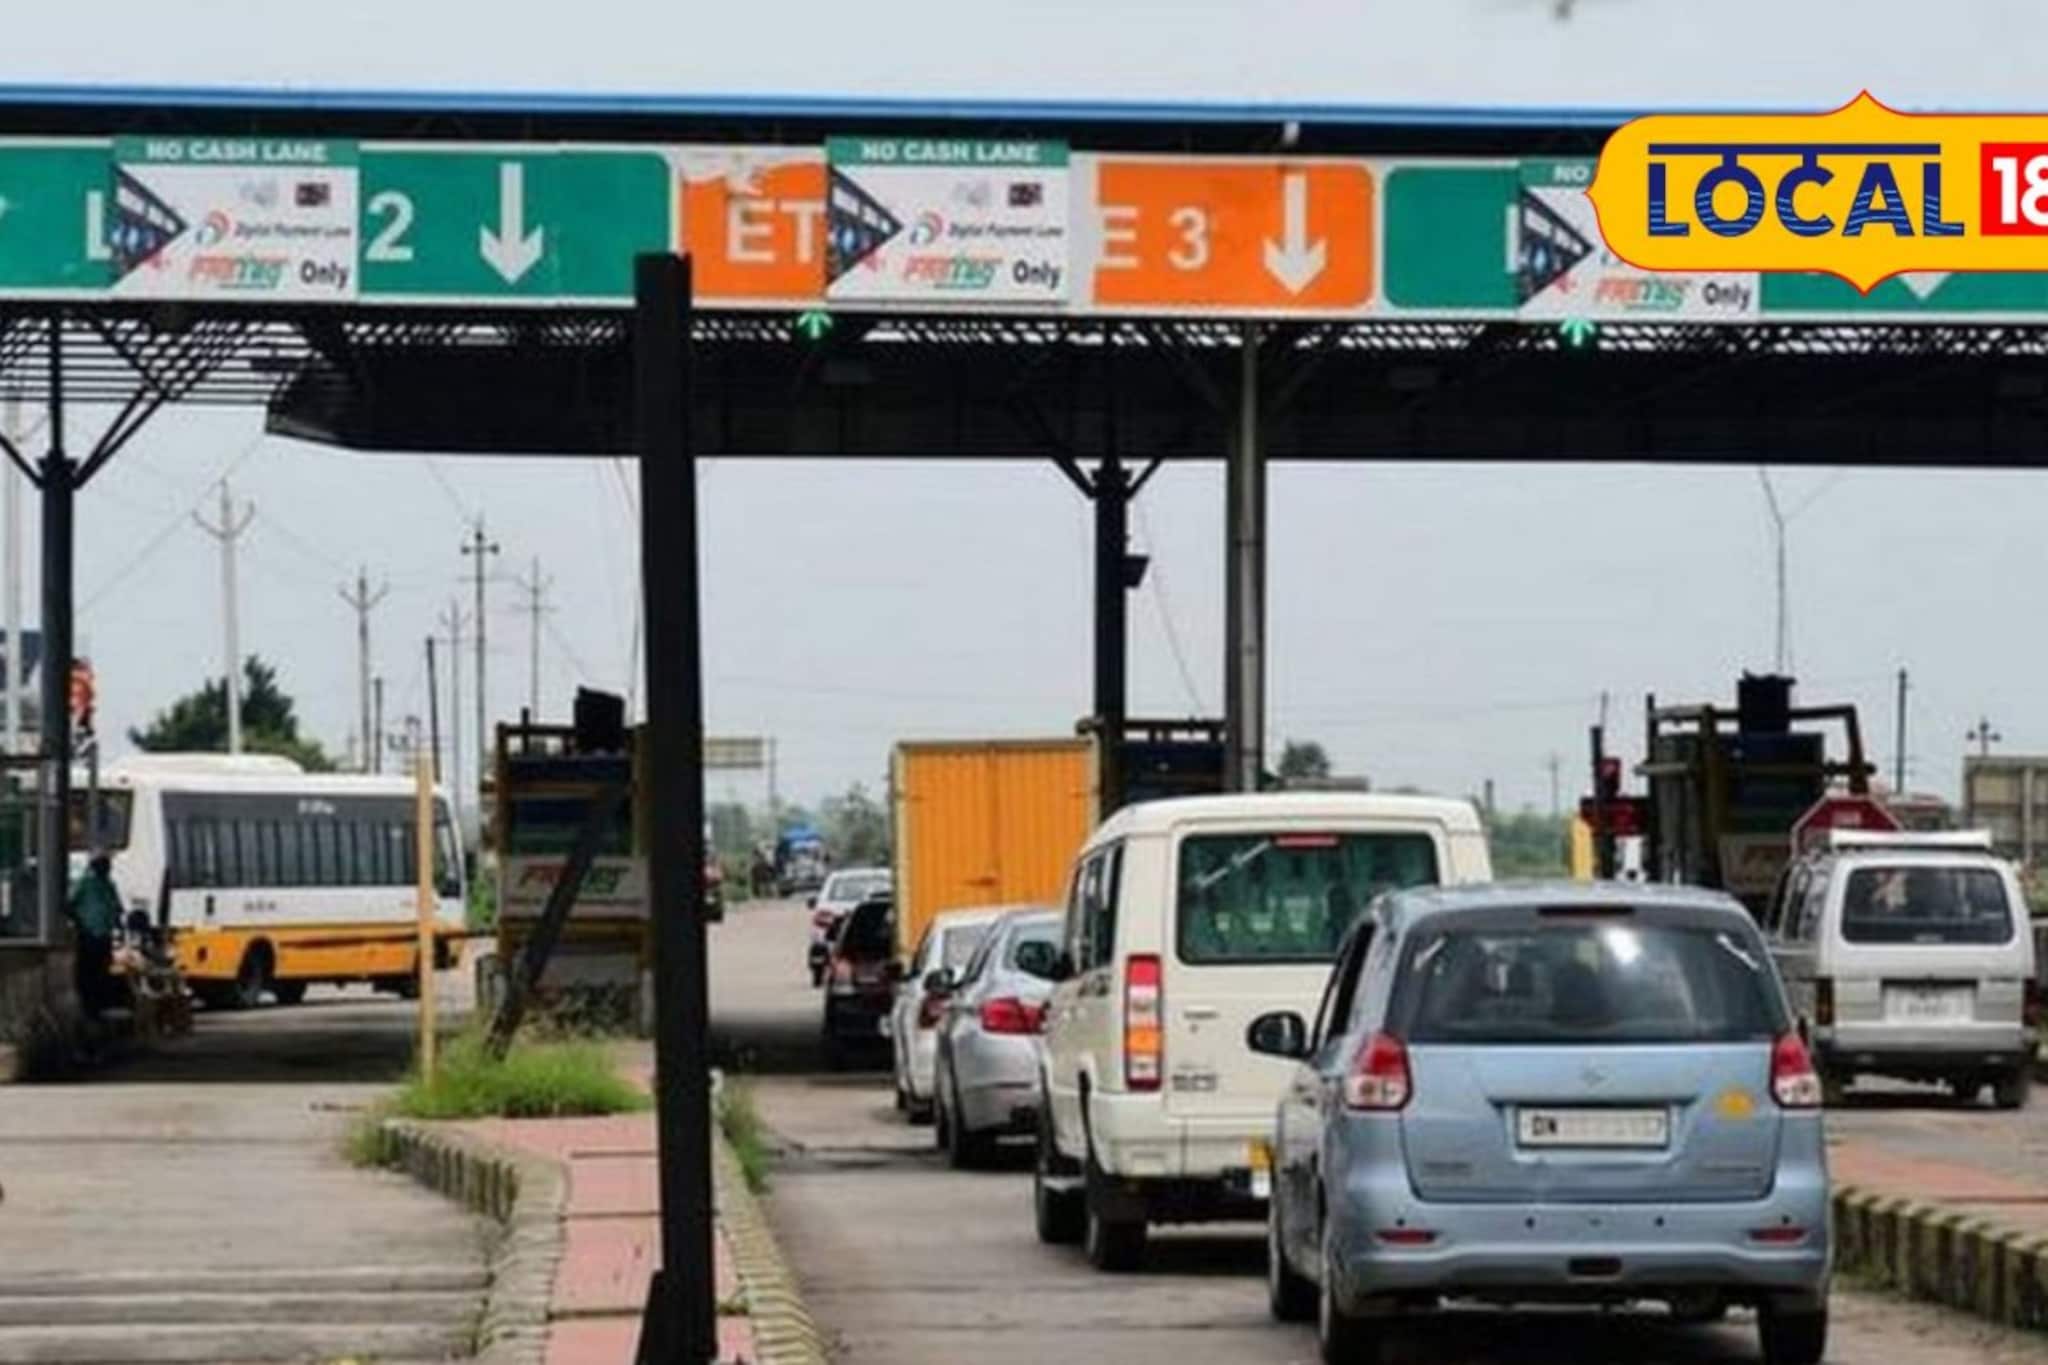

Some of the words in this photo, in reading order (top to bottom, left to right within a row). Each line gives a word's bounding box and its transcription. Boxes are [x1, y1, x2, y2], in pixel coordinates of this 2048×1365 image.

[147, 142, 183, 160] NO
[189, 142, 257, 160] CASH
[263, 143, 329, 161] LANE
[861, 143, 896, 160] NO
[902, 143, 970, 161] CASH
[975, 143, 1041, 161] LANE
[1553, 165, 1590, 182] NO
[366, 190, 414, 261] 2
[1167, 207, 1209, 270] 3
[300, 261, 348, 288] Only
[1013, 259, 1060, 288] Only
[1702, 282, 1750, 310] Only
